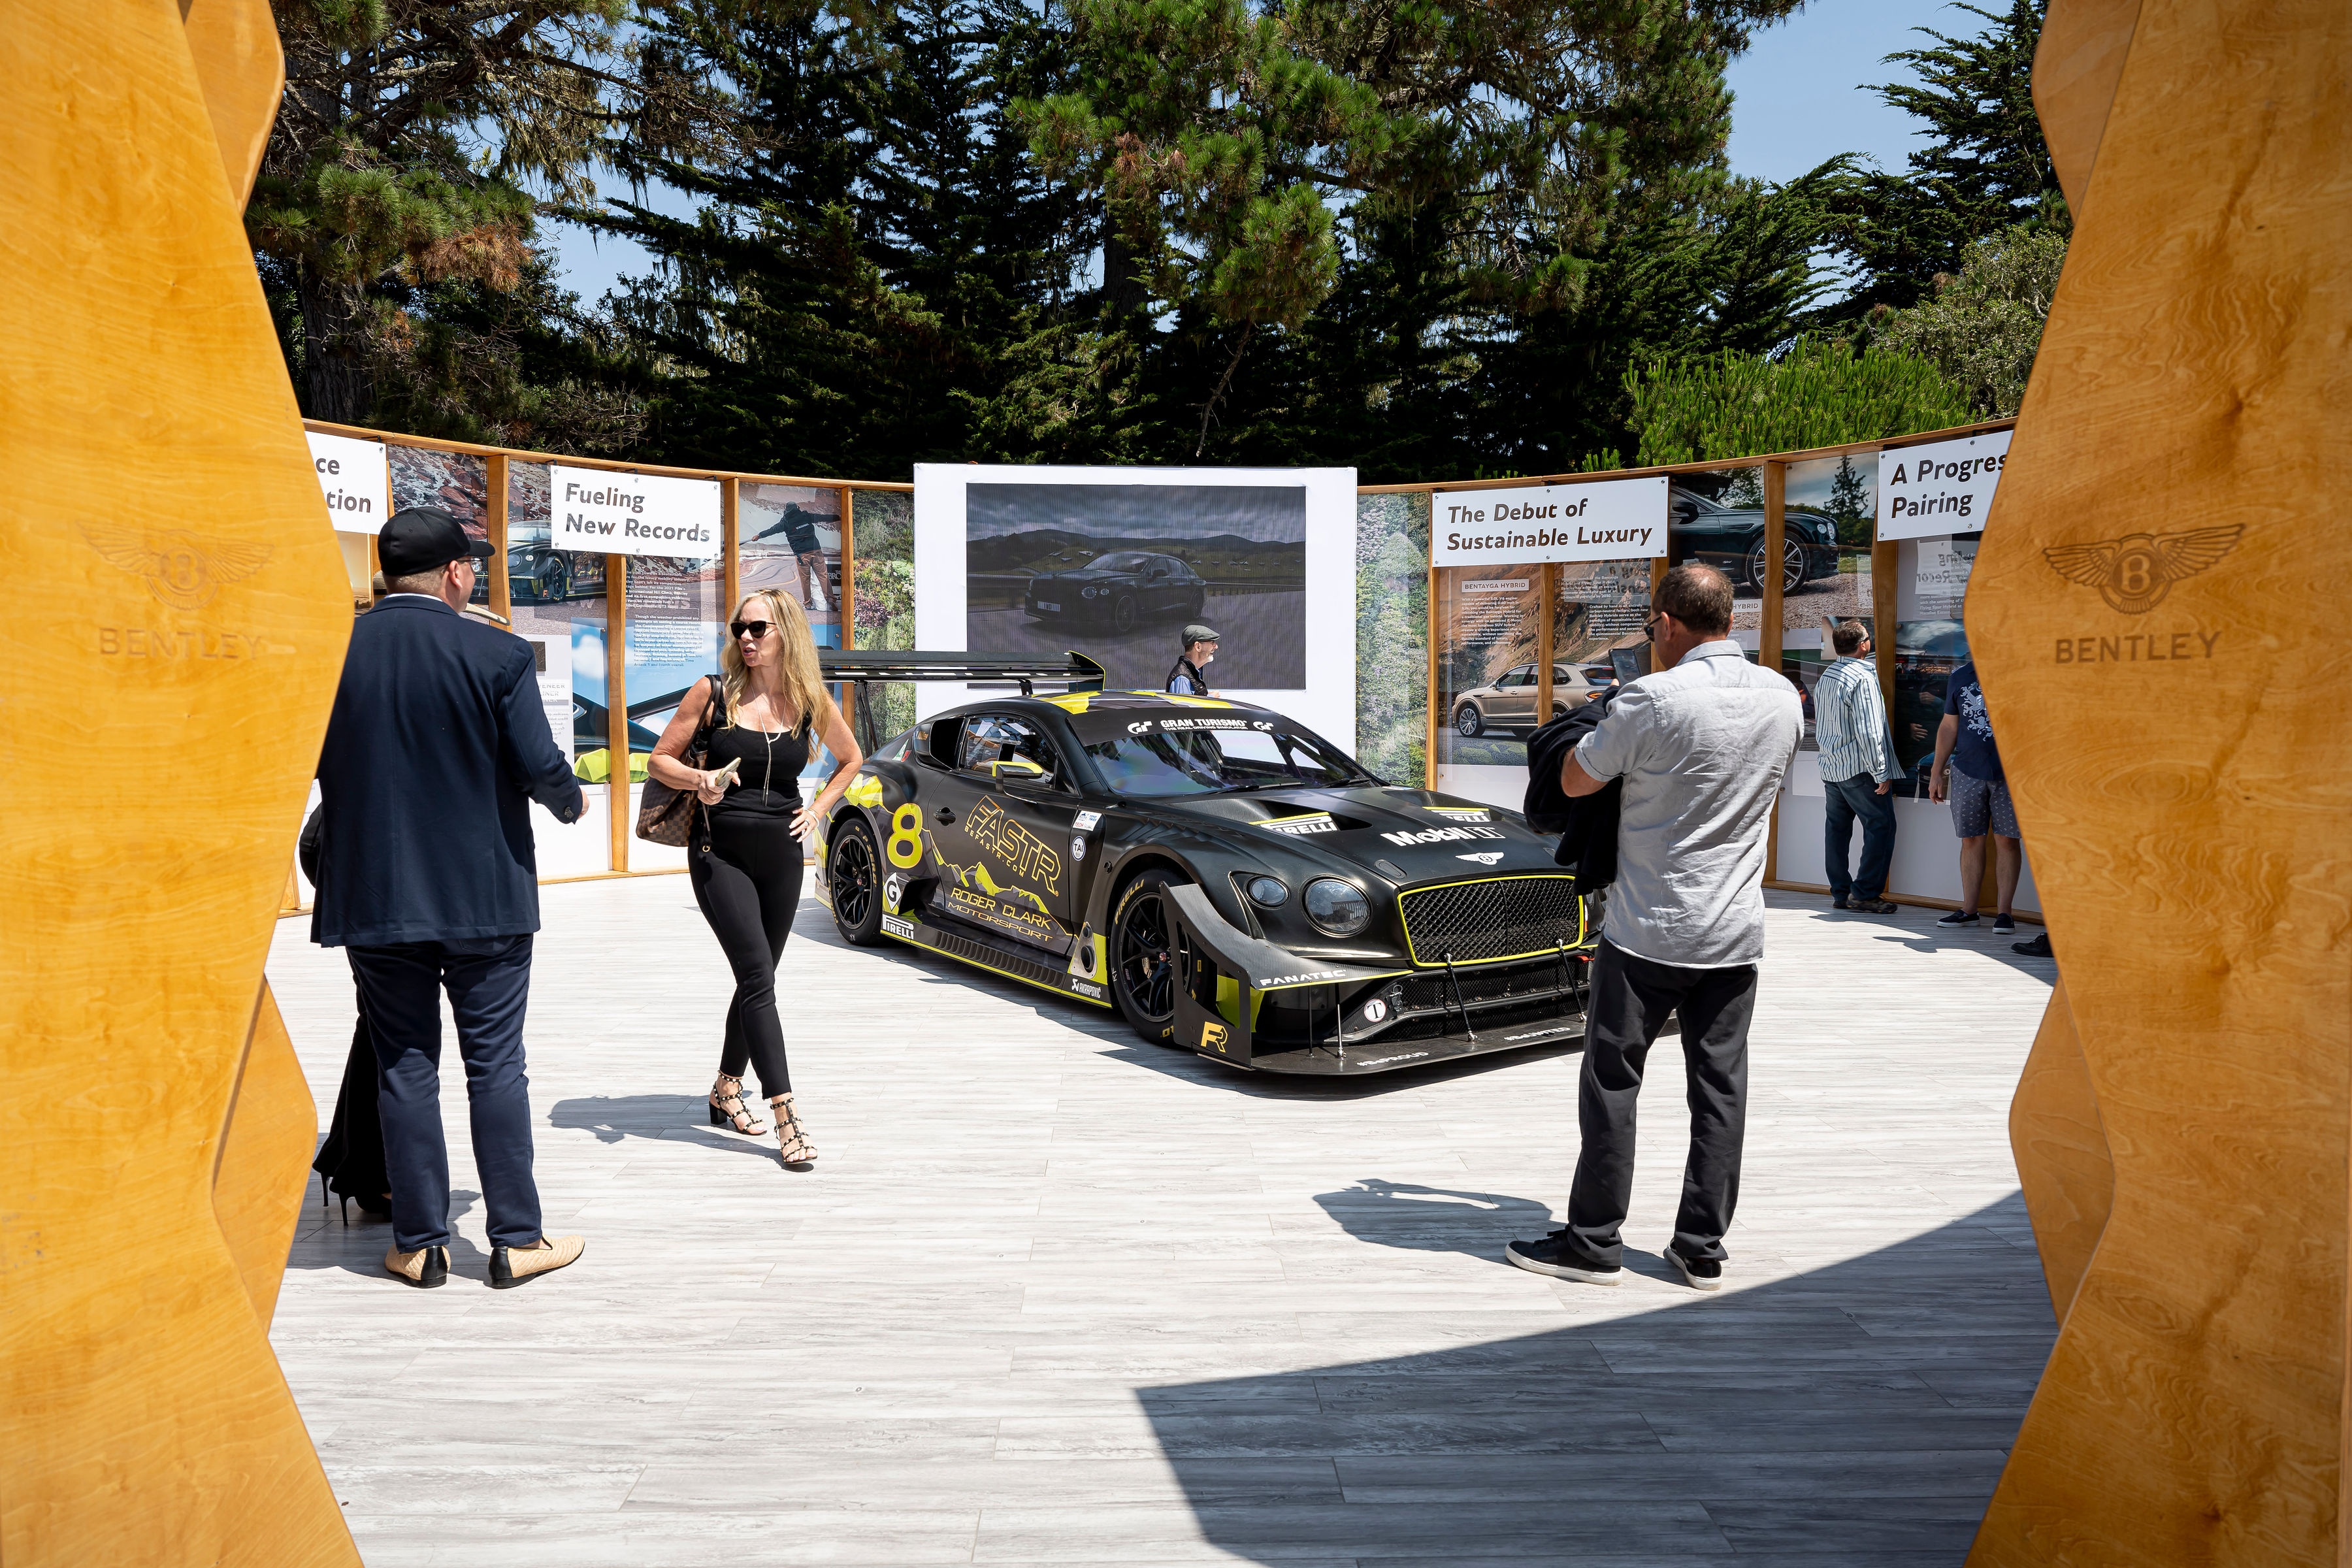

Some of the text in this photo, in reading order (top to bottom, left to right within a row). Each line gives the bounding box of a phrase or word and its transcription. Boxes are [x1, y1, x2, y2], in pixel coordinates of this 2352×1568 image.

[316, 458, 340, 475] ce
[1890, 454, 2007, 485] A Progres
[327, 489, 371, 513] tion
[566, 483, 645, 514] Fueling
[1448, 498, 1588, 523] The Debut of
[1891, 491, 1974, 519] Pairing
[566, 513, 710, 542] New Records
[1447, 527, 1652, 550] Sustainable Luxury
[2121, 555, 2151, 594] B
[99, 627, 261, 659] BENTLEY
[2056, 631, 2221, 664] BENTLEY
[1160, 718, 1247, 728] GRAN TURISMO
[1431, 809, 1490, 823] PELLI
[887, 803, 923, 868] 8
[966, 794, 1061, 896] FASTR
[1074, 843, 1083, 852] TAI
[1380, 826, 1477, 847] Mobil
[964, 826, 1024, 877] BEFASTR.COM
[887, 880, 897, 902] G
[1115, 879, 1145, 924] PIRELLI
[947, 902, 1053, 941] MOTORSPORT
[951, 887, 1052, 930] ROGER CLARK
[883, 914, 914, 940] PIRELLI
[1260, 970, 1346, 986] FANATEC
[1367, 1002, 1383, 1019] T
[1504, 1026, 1571, 1041] #BeUNITED
[1357, 1051, 1429, 1067] #BePROUD
